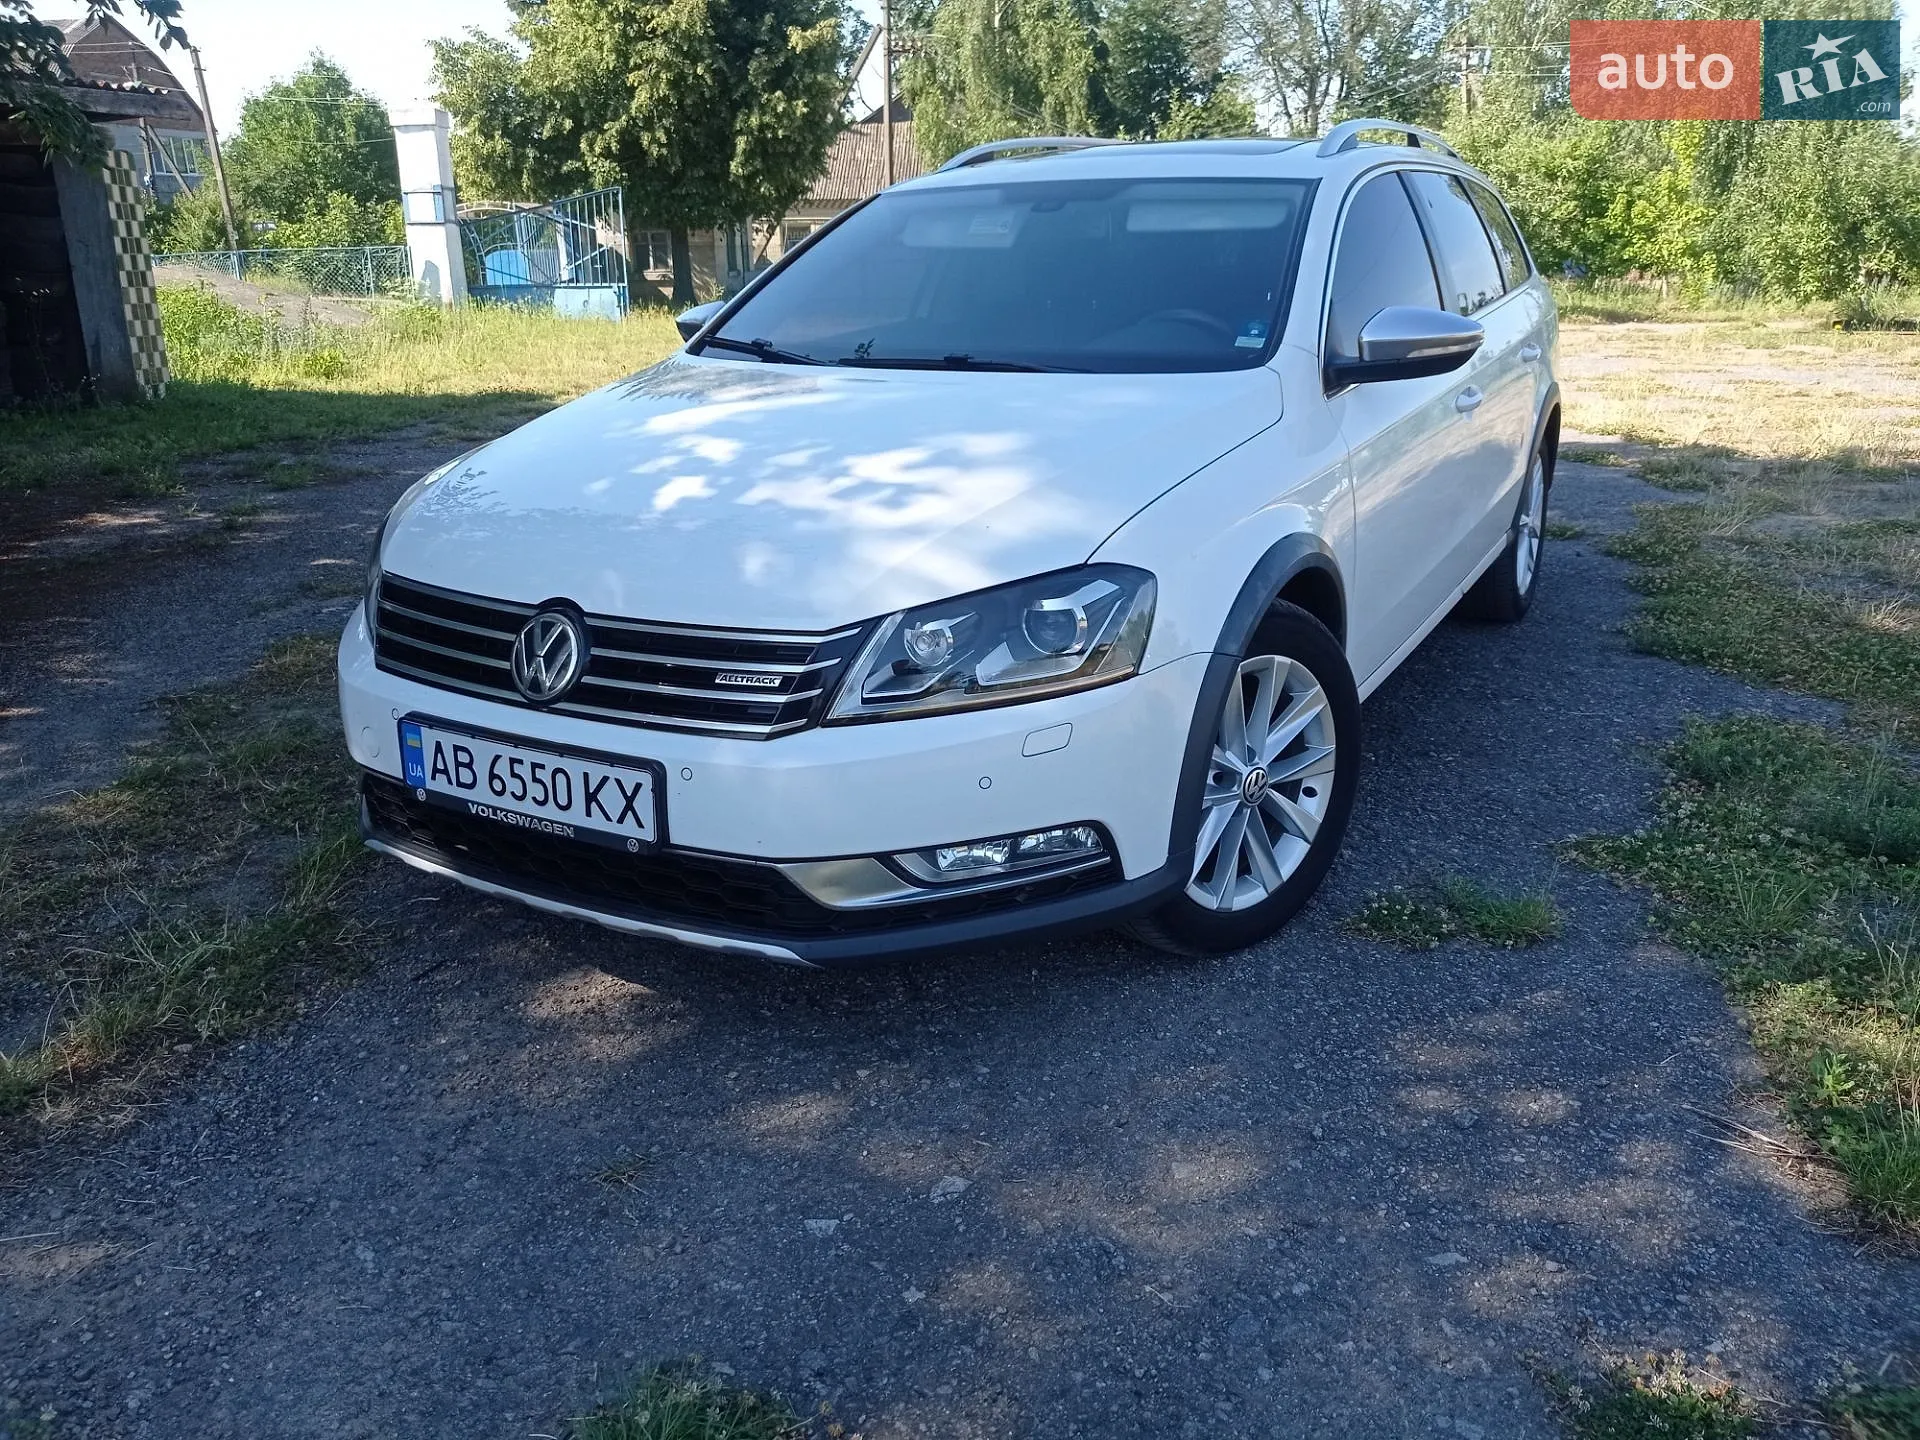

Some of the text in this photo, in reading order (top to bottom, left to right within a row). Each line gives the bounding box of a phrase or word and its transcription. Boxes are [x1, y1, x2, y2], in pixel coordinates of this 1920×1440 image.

[408, 762, 424, 779] UA
[430, 740, 645, 830] AB 6550 KX
[467, 802, 575, 838] VOLKSWAGEN
